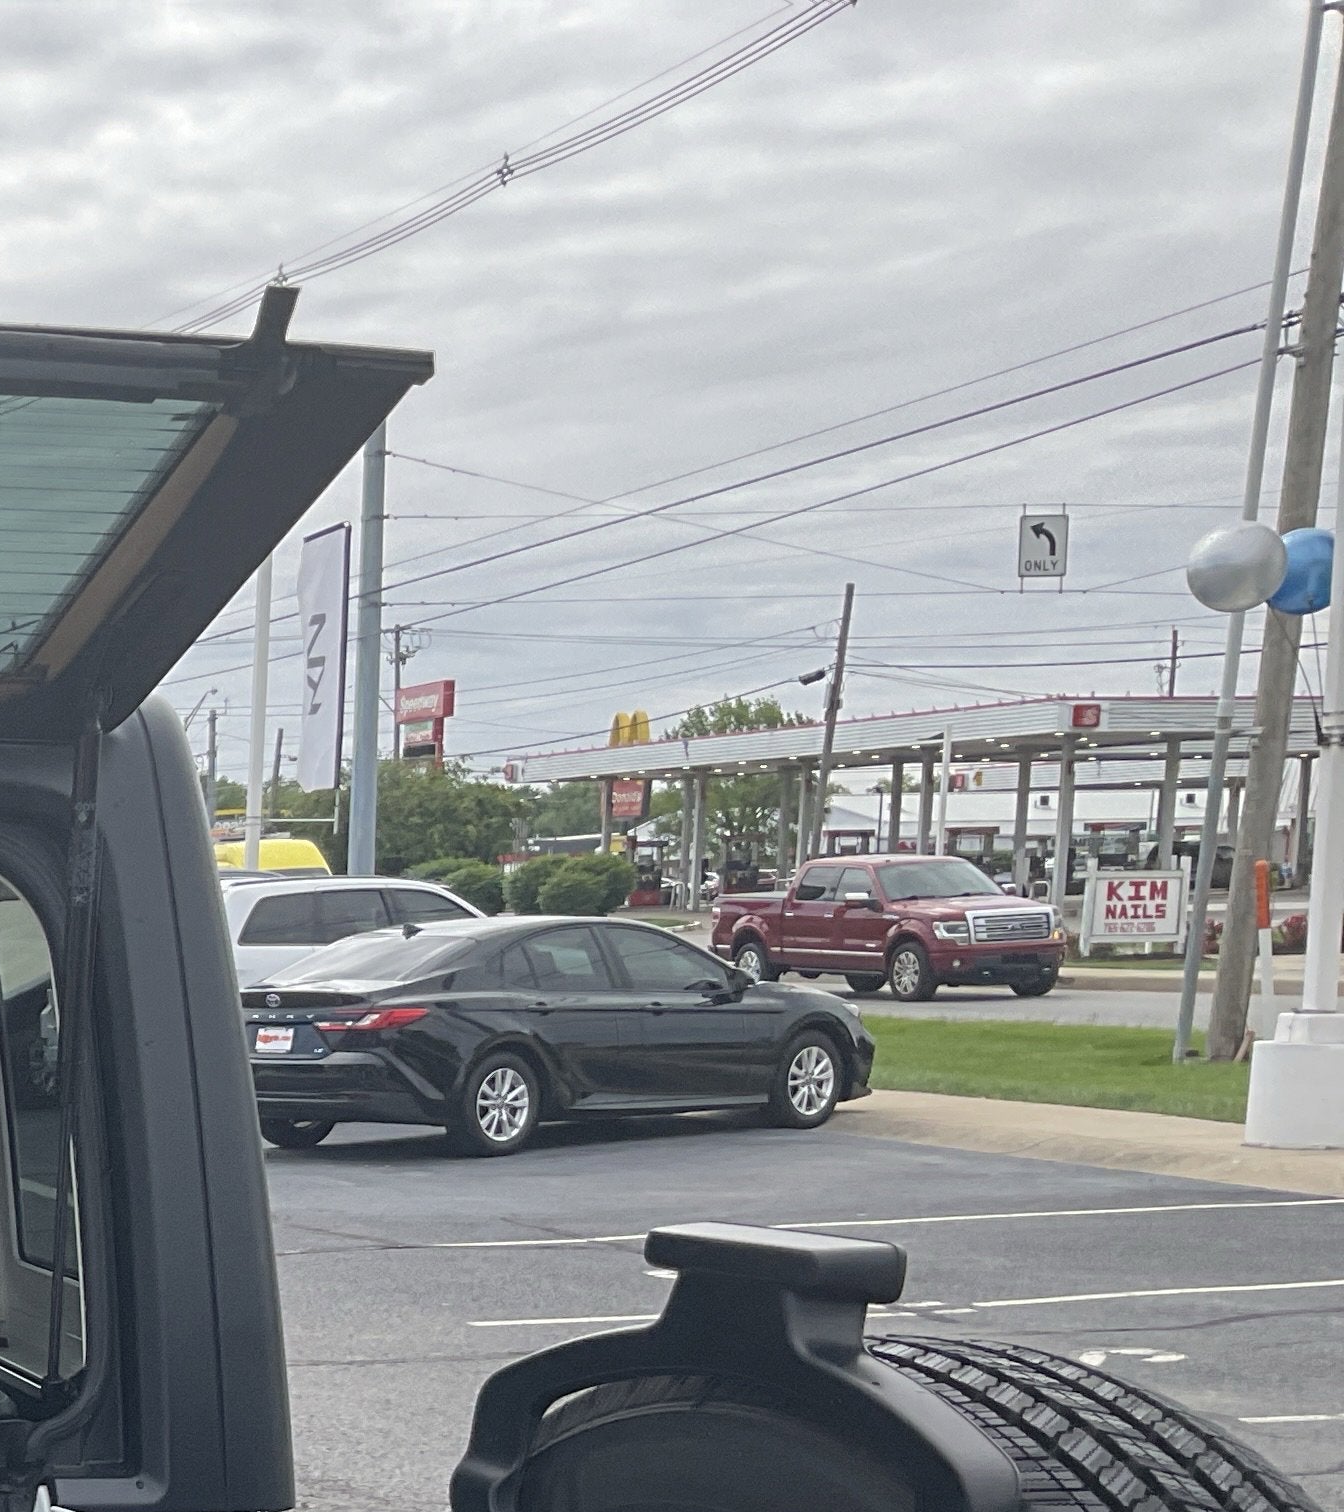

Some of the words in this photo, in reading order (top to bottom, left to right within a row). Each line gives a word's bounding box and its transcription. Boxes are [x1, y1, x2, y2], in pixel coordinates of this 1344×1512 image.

[1024, 559, 1059, 571] ONLY
[1106, 880, 1169, 901] KIM
[1104, 903, 1167, 920] NAILS
